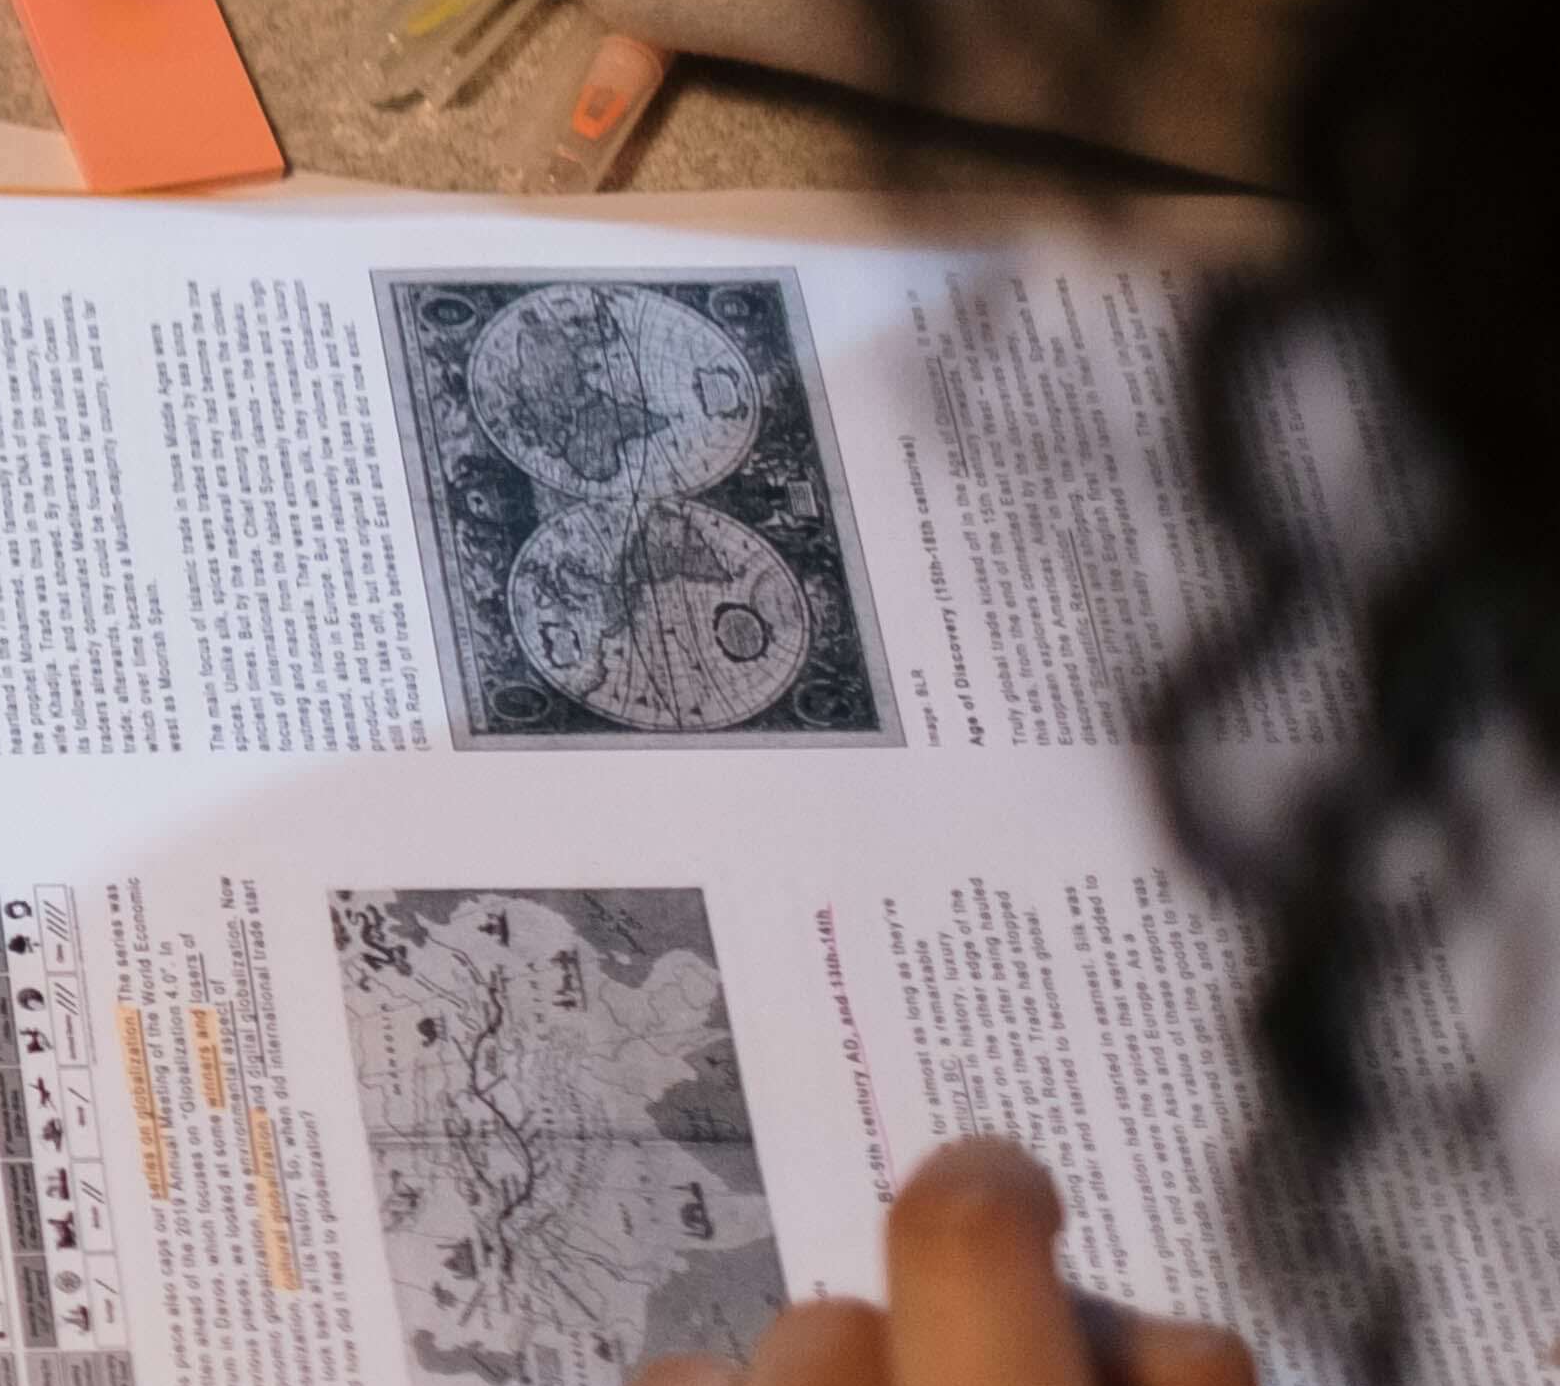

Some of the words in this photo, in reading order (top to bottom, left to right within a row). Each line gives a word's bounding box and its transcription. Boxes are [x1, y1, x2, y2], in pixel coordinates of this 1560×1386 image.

[898, 434, 930, 515] centuries)
[919, 519, 953, 602] (15th-18th
[151, 630, 173, 690] Moorish
[941, 606, 971, 689] Discovery
[162, 694, 177, 713] as
[956, 693, 975, 711] of
[164, 717, 182, 753] west
[966, 715, 985, 747] Age
[127, 876, 151, 953] Economic
[815, 909, 845, 988] 13th-14th
[136, 957, 157, 1006] World
[146, 1011, 162, 1038] the
[832, 993, 855, 1027] and
[148, 1041, 165, 1059] of
[153, 1064, 175, 1129] Meeting
[852, 1069, 878, 1137] century
[160, 1133, 184, 1192] Annual
[170, 1196, 193, 1237] 2019
[180, 1242, 196, 1269] the
[181, 1273, 201, 1291] of
[186, 1295, 210, 1348] ahead
